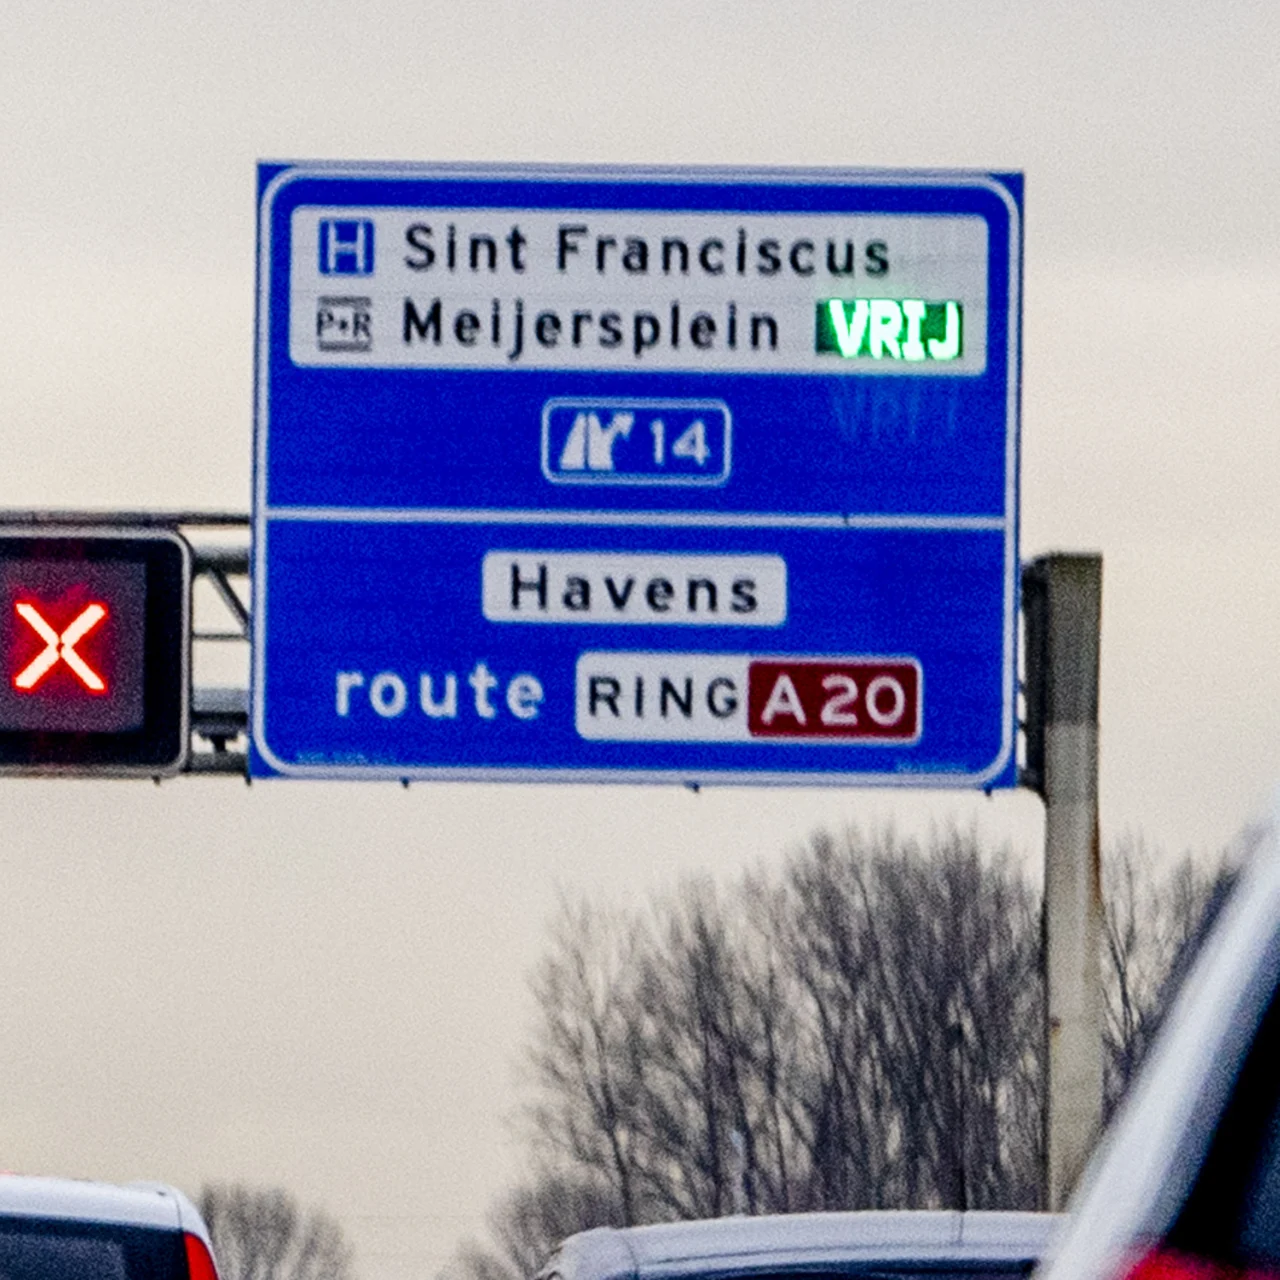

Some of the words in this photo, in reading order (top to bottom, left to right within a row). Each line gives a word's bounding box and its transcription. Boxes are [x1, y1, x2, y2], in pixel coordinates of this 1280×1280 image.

[404, 224, 527, 272] Sint
[557, 225, 890, 277] Franciscus
[403, 299, 779, 360] Meijersplein
[829, 299, 960, 361] VRIJ
[650, 420, 711, 467] 14
[510, 563, 758, 614] Havens
[336, 663, 544, 719] route
[588, 676, 739, 719] RING
[761, 676, 906, 726] A20
